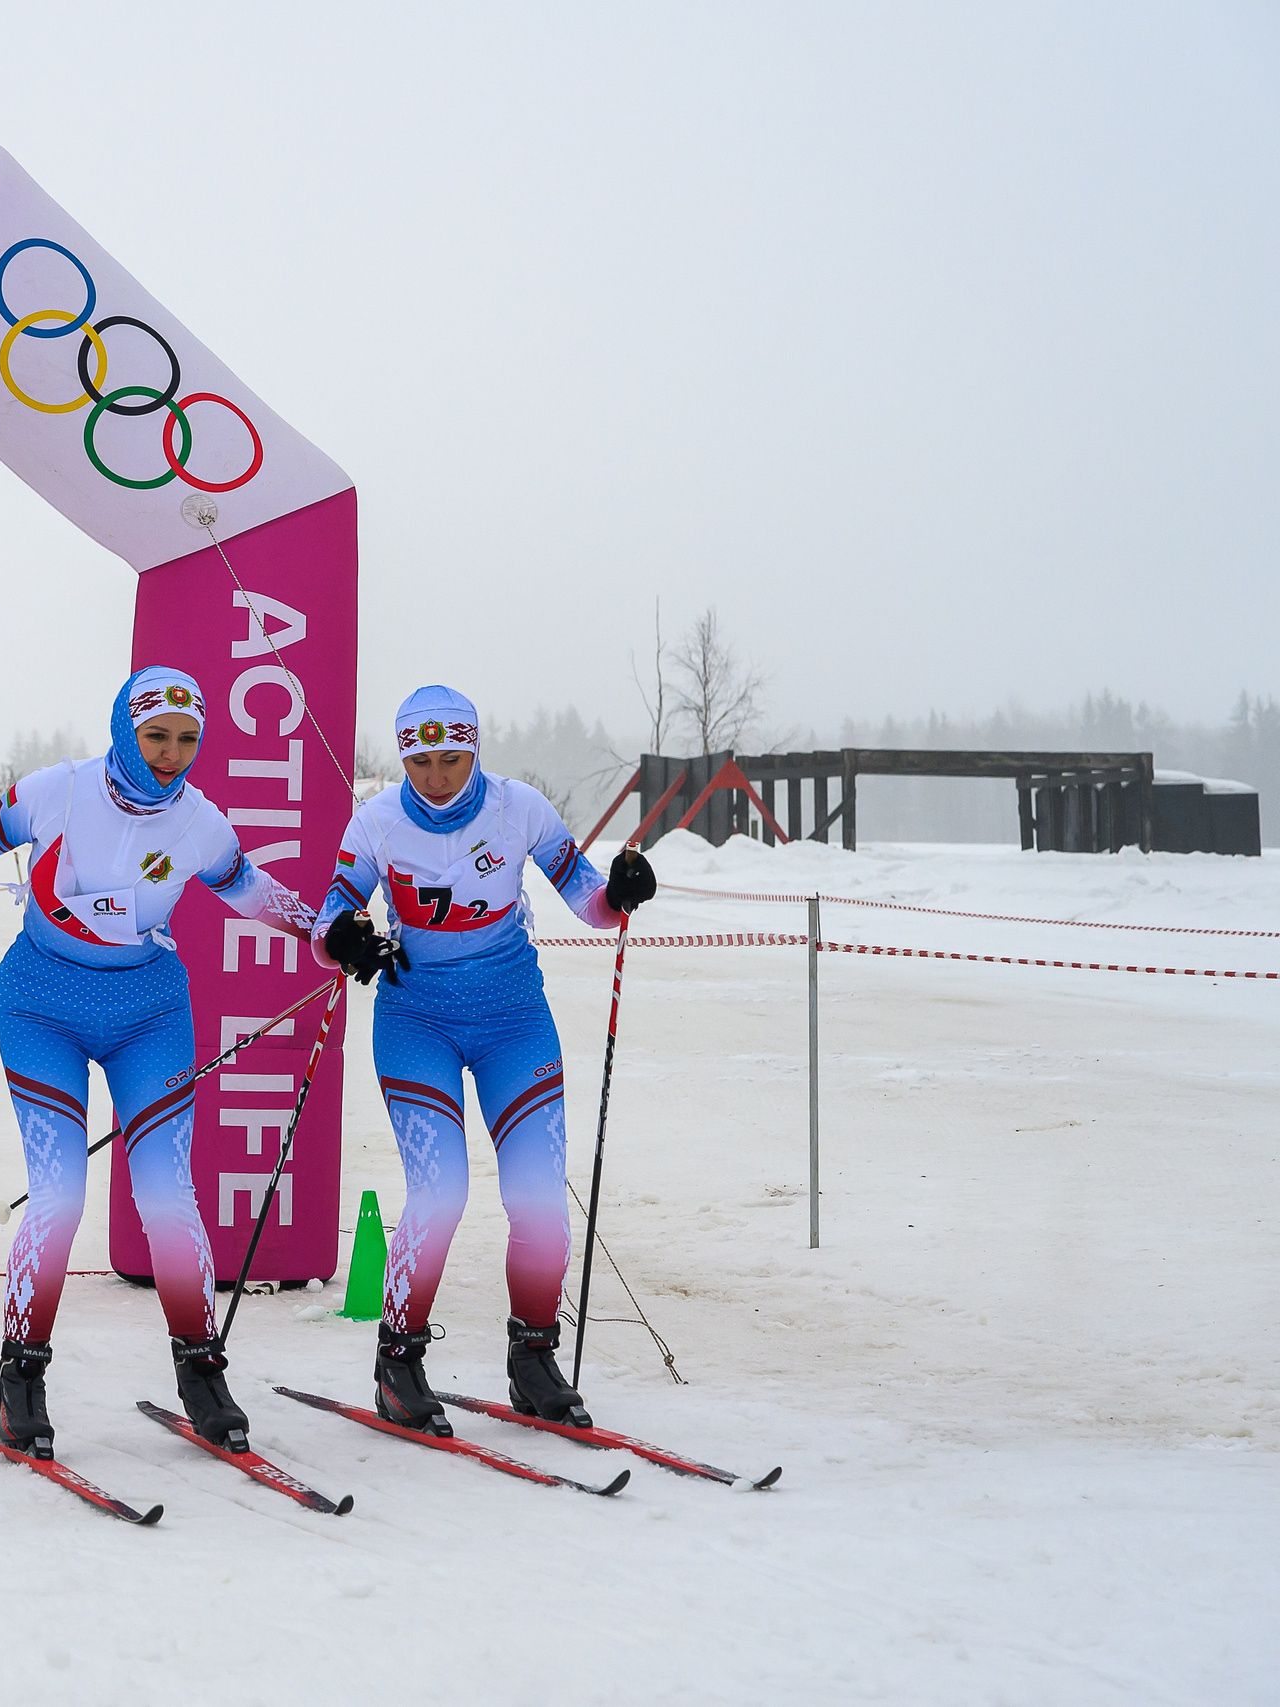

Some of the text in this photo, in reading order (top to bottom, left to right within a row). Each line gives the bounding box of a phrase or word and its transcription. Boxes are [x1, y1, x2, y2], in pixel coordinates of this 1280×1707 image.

[164, 1059, 196, 1089] ORA
[533, 1055, 563, 1078] ORA
[218, 1016, 296, 1228] LIFE
[23, 1349, 51, 1358] MARA
